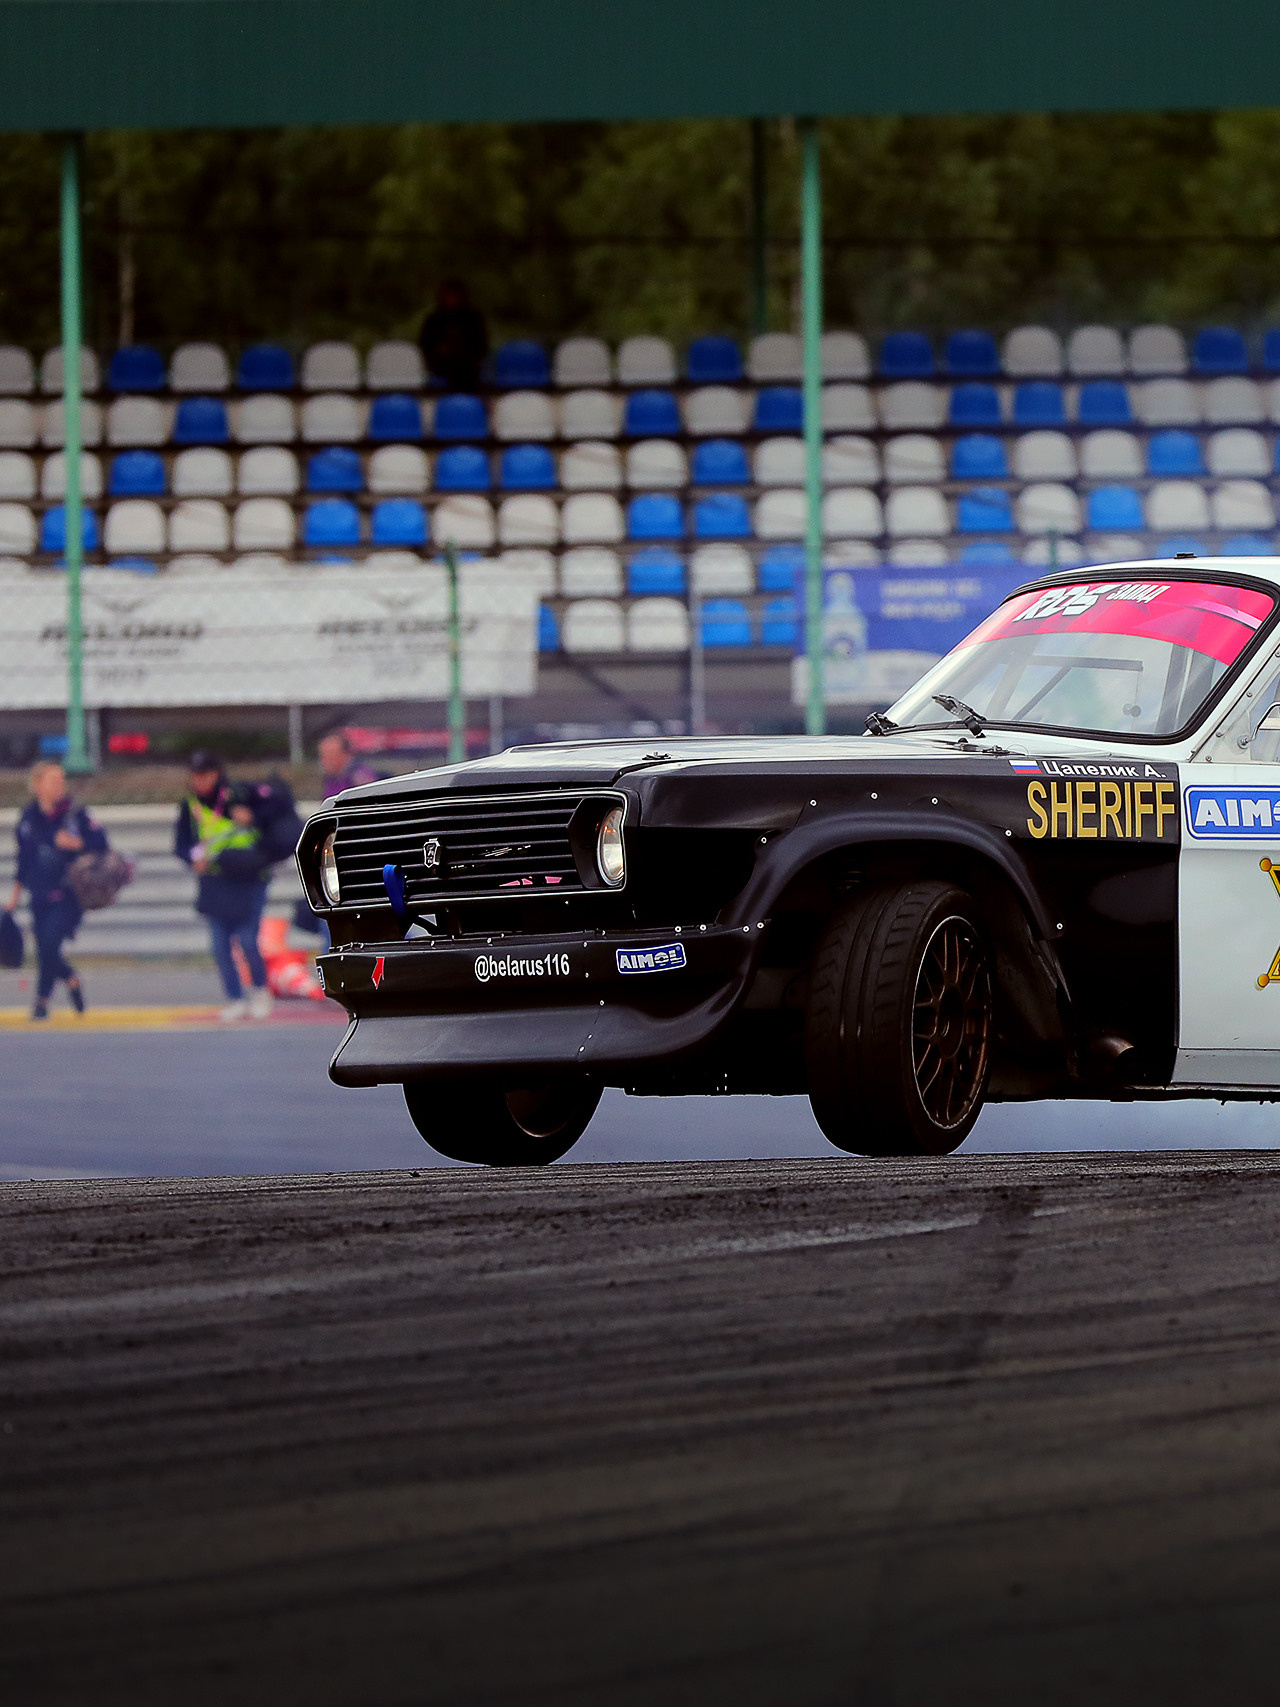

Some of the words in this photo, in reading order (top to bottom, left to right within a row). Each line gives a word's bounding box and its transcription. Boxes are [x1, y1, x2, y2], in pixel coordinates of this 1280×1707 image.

[1041, 760, 1140, 778] Цапелик
[1026, 780, 1176, 839] SHERIFF
[474, 952, 571, 983] @belarus116
